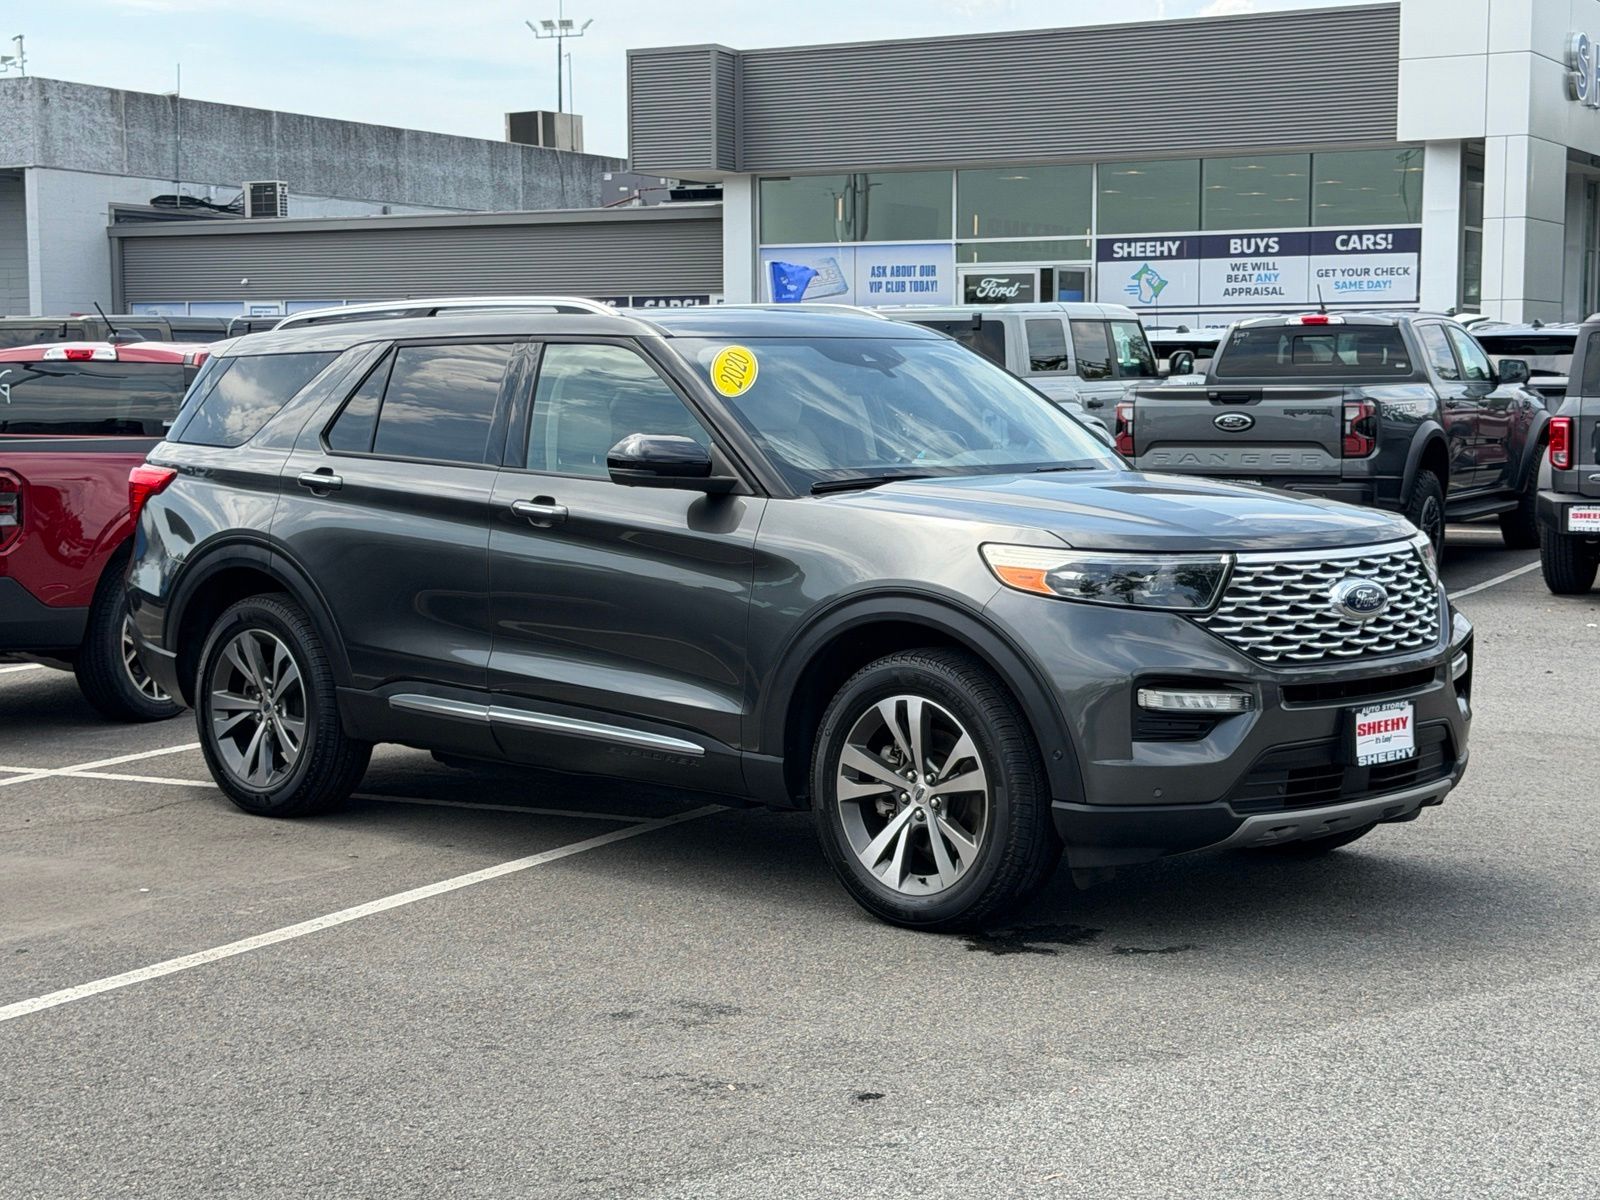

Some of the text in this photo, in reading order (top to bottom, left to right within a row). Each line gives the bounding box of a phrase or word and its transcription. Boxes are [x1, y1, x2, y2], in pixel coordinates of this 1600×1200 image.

[1112, 233, 1393, 258] SHEEHY BUYS CARS!
[870, 264, 937, 278] ASK ABOUT OUR
[1230, 261, 1279, 272] WE WILL
[1316, 266, 1411, 278] GET YOUR CHECK
[1226, 273, 1280, 283] BEAT ANY
[1333, 279, 1393, 291] SAME DAY!
[868, 280, 938, 294] VIP CLUB TODAY!
[976, 277, 1020, 298] Ford
[1222, 286, 1285, 297] APPRAISAL
[720, 351, 750, 390] 2020
[1381, 402, 1417, 418] RAPTOR
[1151, 452, 1322, 467] RANGER
[1355, 588, 1380, 609] Ford
[1361, 706, 1381, 714] AUTO
[1357, 716, 1409, 737] SHEEHY
[1358, 747, 1415, 766] SHEEHY
